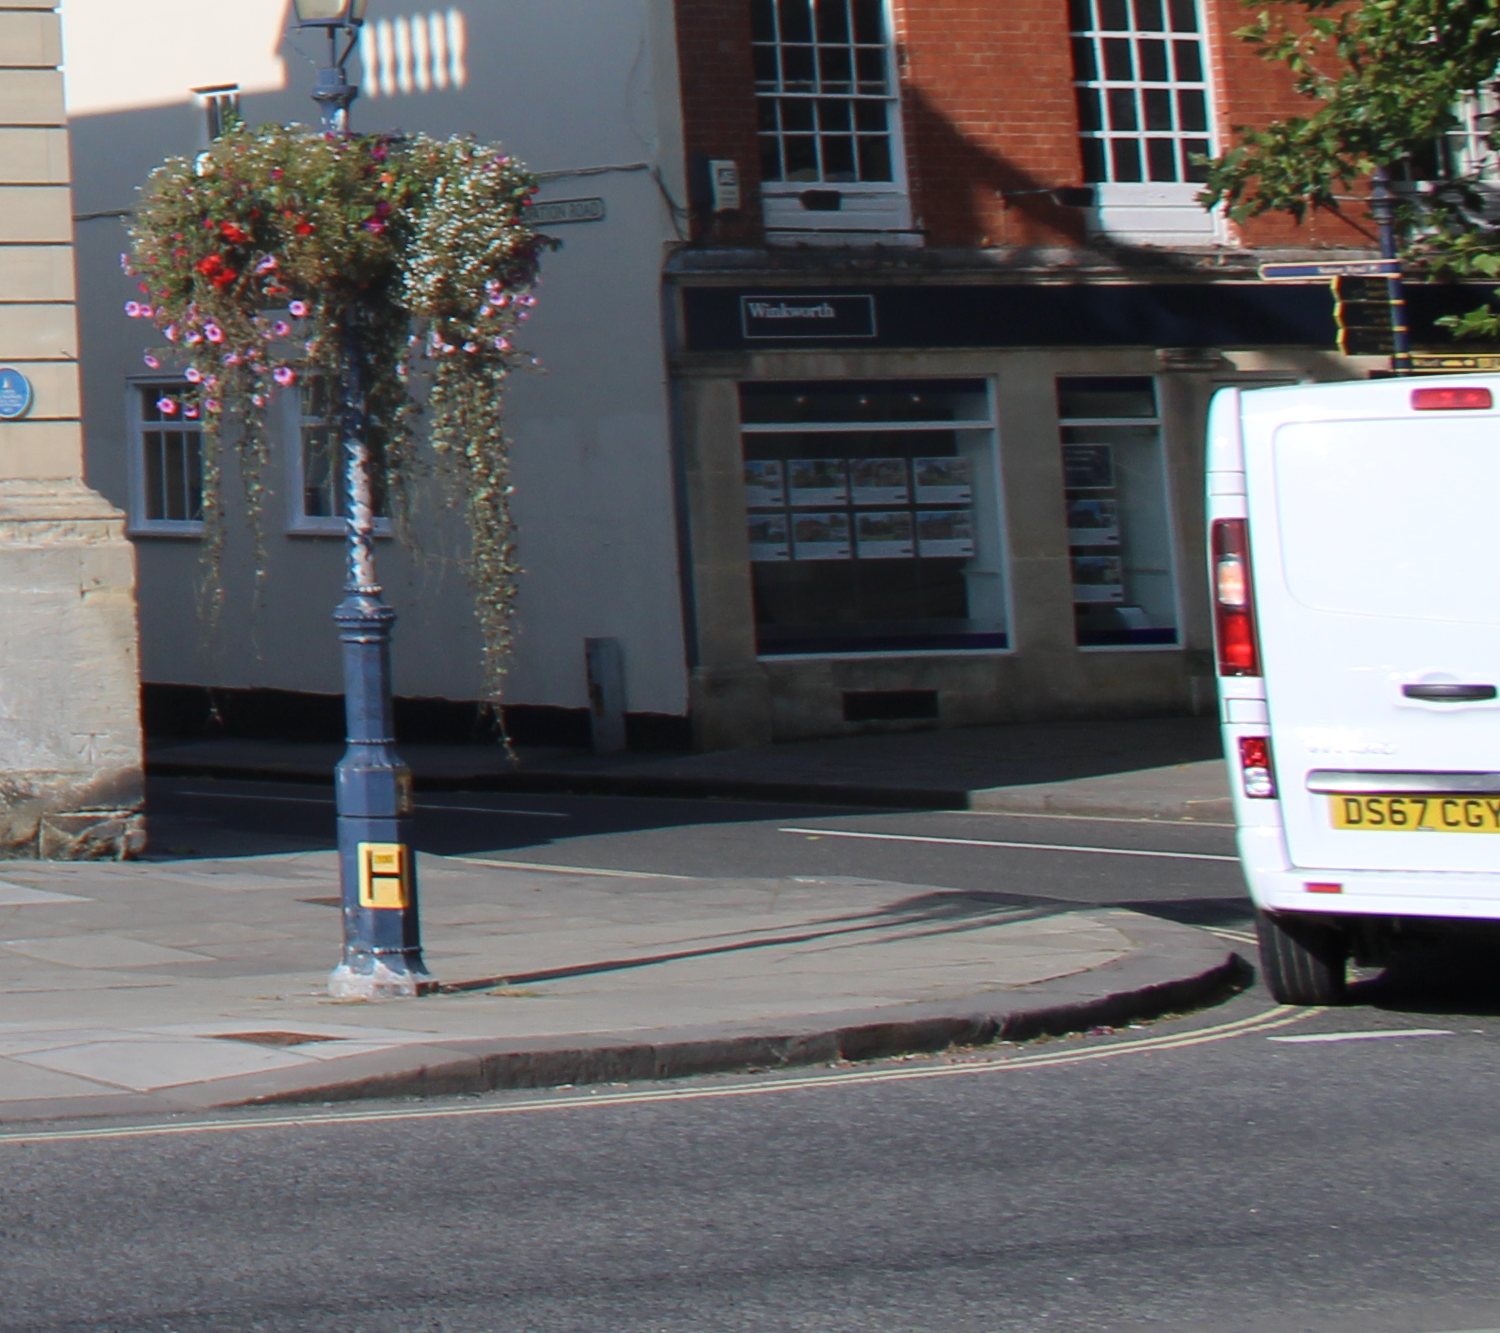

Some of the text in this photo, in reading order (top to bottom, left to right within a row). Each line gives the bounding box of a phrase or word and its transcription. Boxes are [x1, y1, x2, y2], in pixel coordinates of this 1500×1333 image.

[569, 201, 600, 218] ROAD
[748, 302, 836, 318] Winkworth
[1343, 798, 1428, 827] DS67
